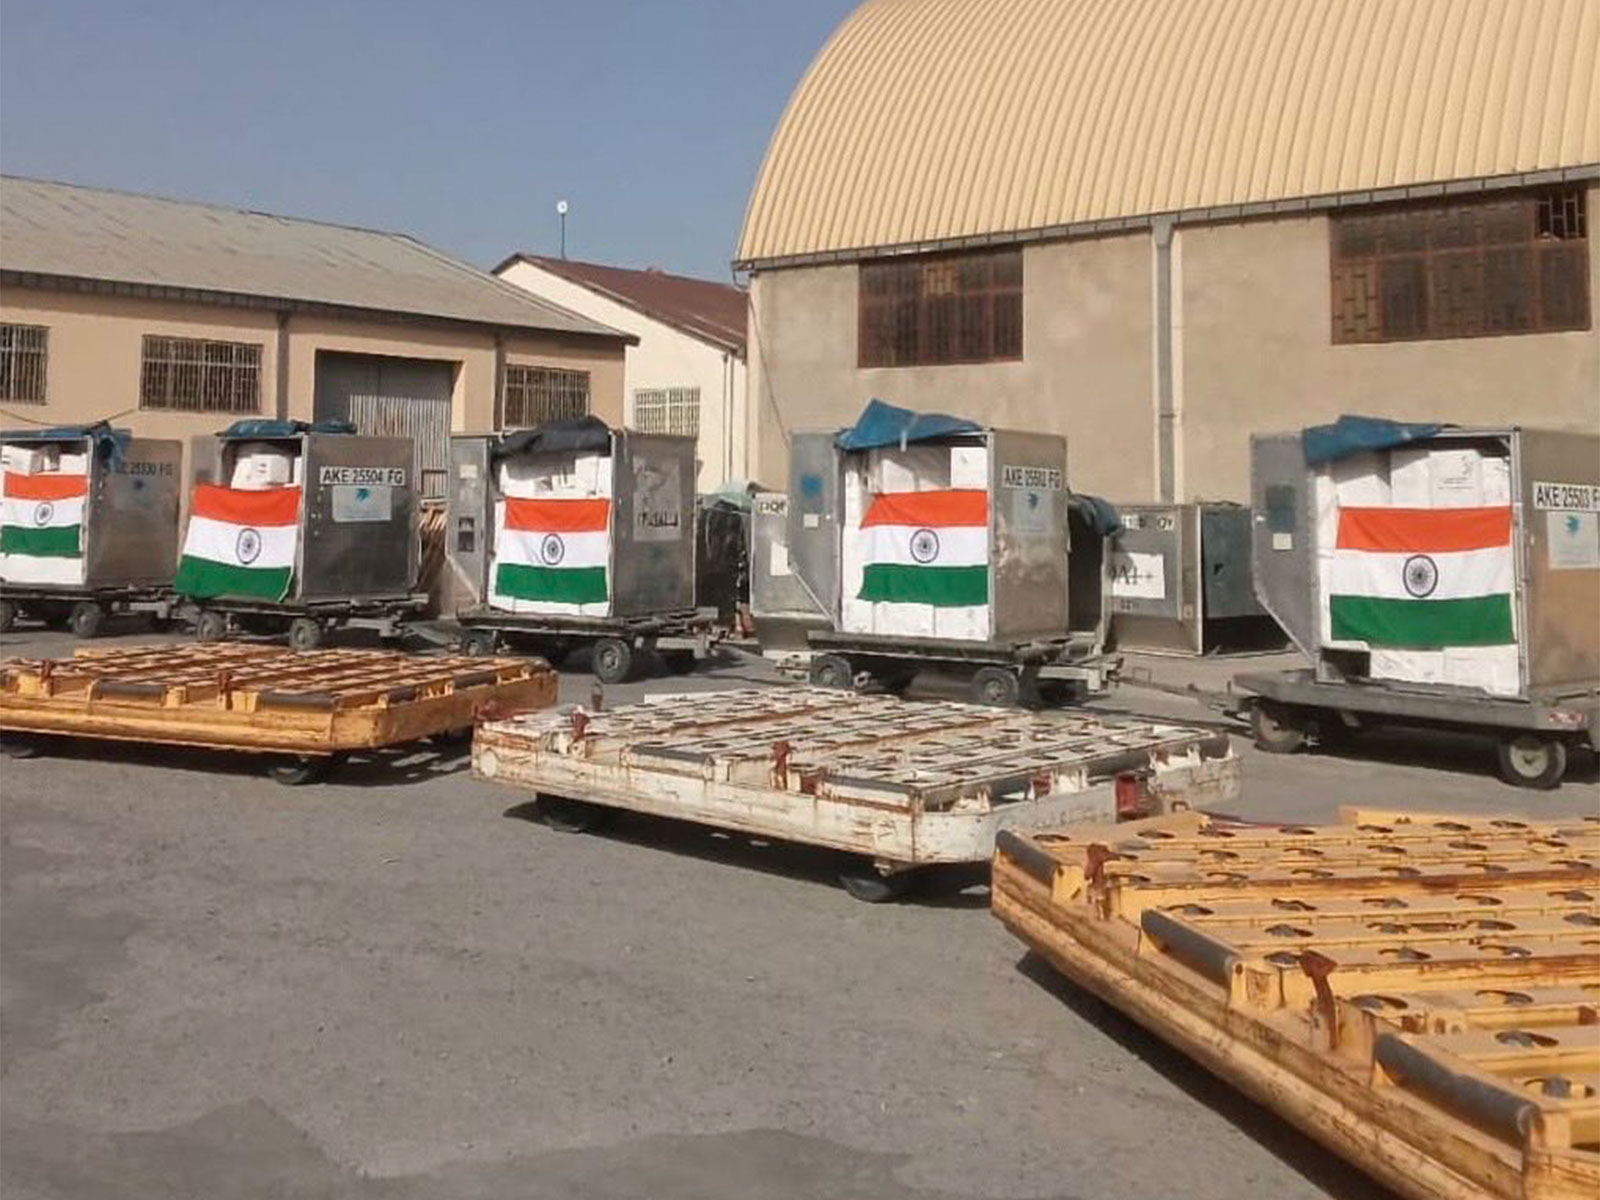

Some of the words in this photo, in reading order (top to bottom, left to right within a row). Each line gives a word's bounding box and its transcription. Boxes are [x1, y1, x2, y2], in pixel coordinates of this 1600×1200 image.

[322, 469, 349, 483] AKE
[387, 469, 403, 484] FG
[1005, 466, 1023, 487] AKE
[1048, 471, 1061, 489] FG
[1536, 485, 1560, 508] AKE
